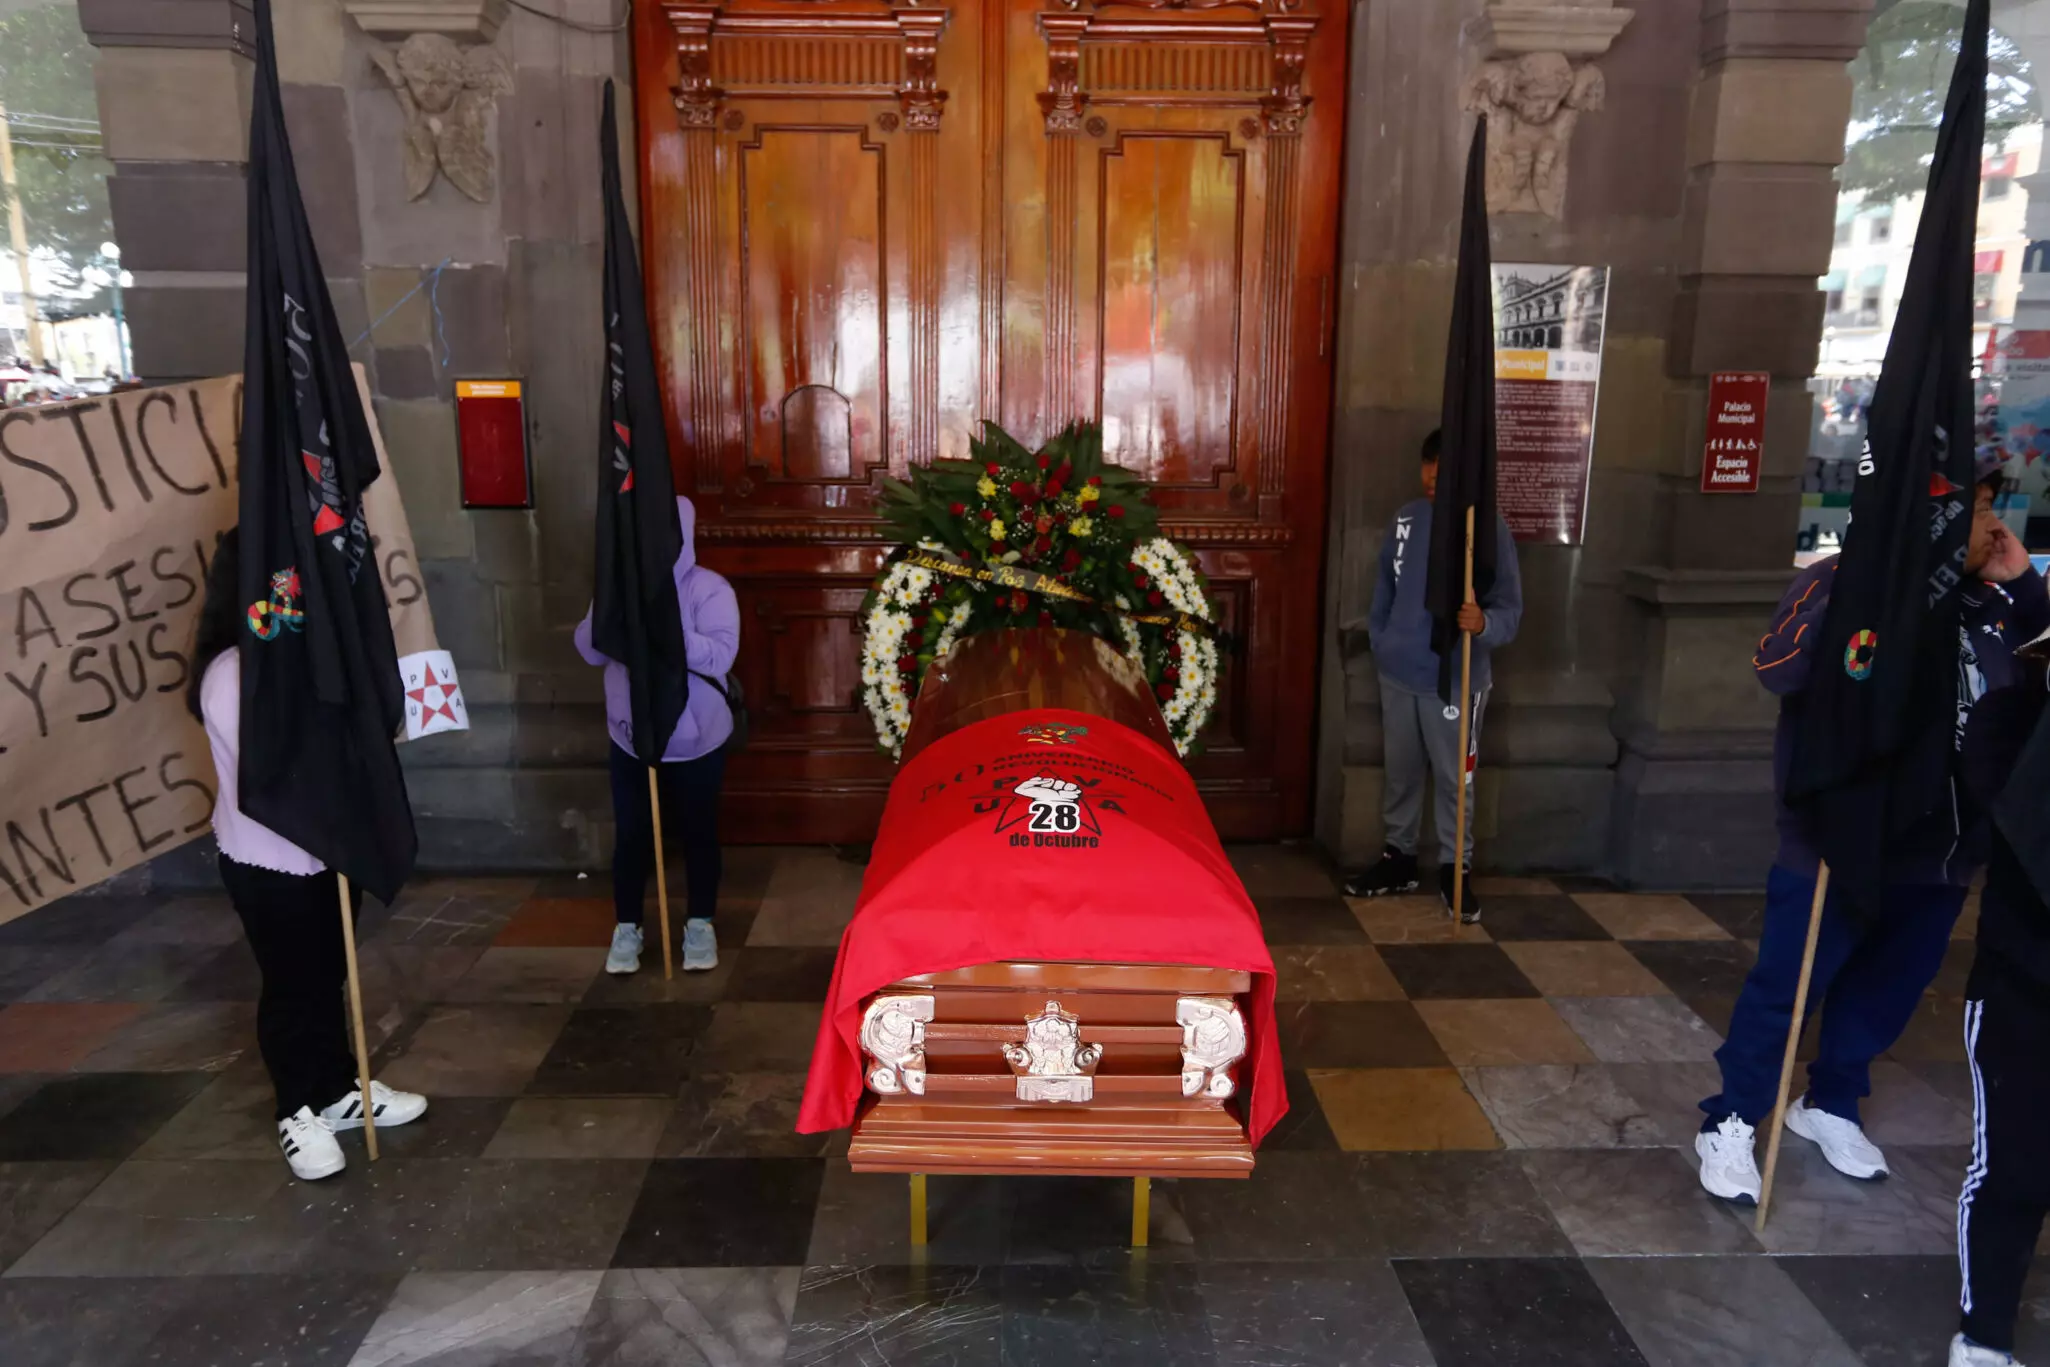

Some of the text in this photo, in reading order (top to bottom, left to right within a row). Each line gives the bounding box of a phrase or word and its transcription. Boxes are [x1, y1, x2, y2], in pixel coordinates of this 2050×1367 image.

[1724, 401, 1752, 412] Palacio
[1717, 412, 1756, 425] Municipal
[1716, 454, 1749, 470] Espacio
[1711, 469, 1751, 483] Accesible
[1393, 523, 1412, 584] NIK
[976, 569, 995, 581] en
[5, 622, 189, 738] Y SUS
[1029, 802, 1079, 832] 28
[1009, 832, 1099, 848] de Octubre
